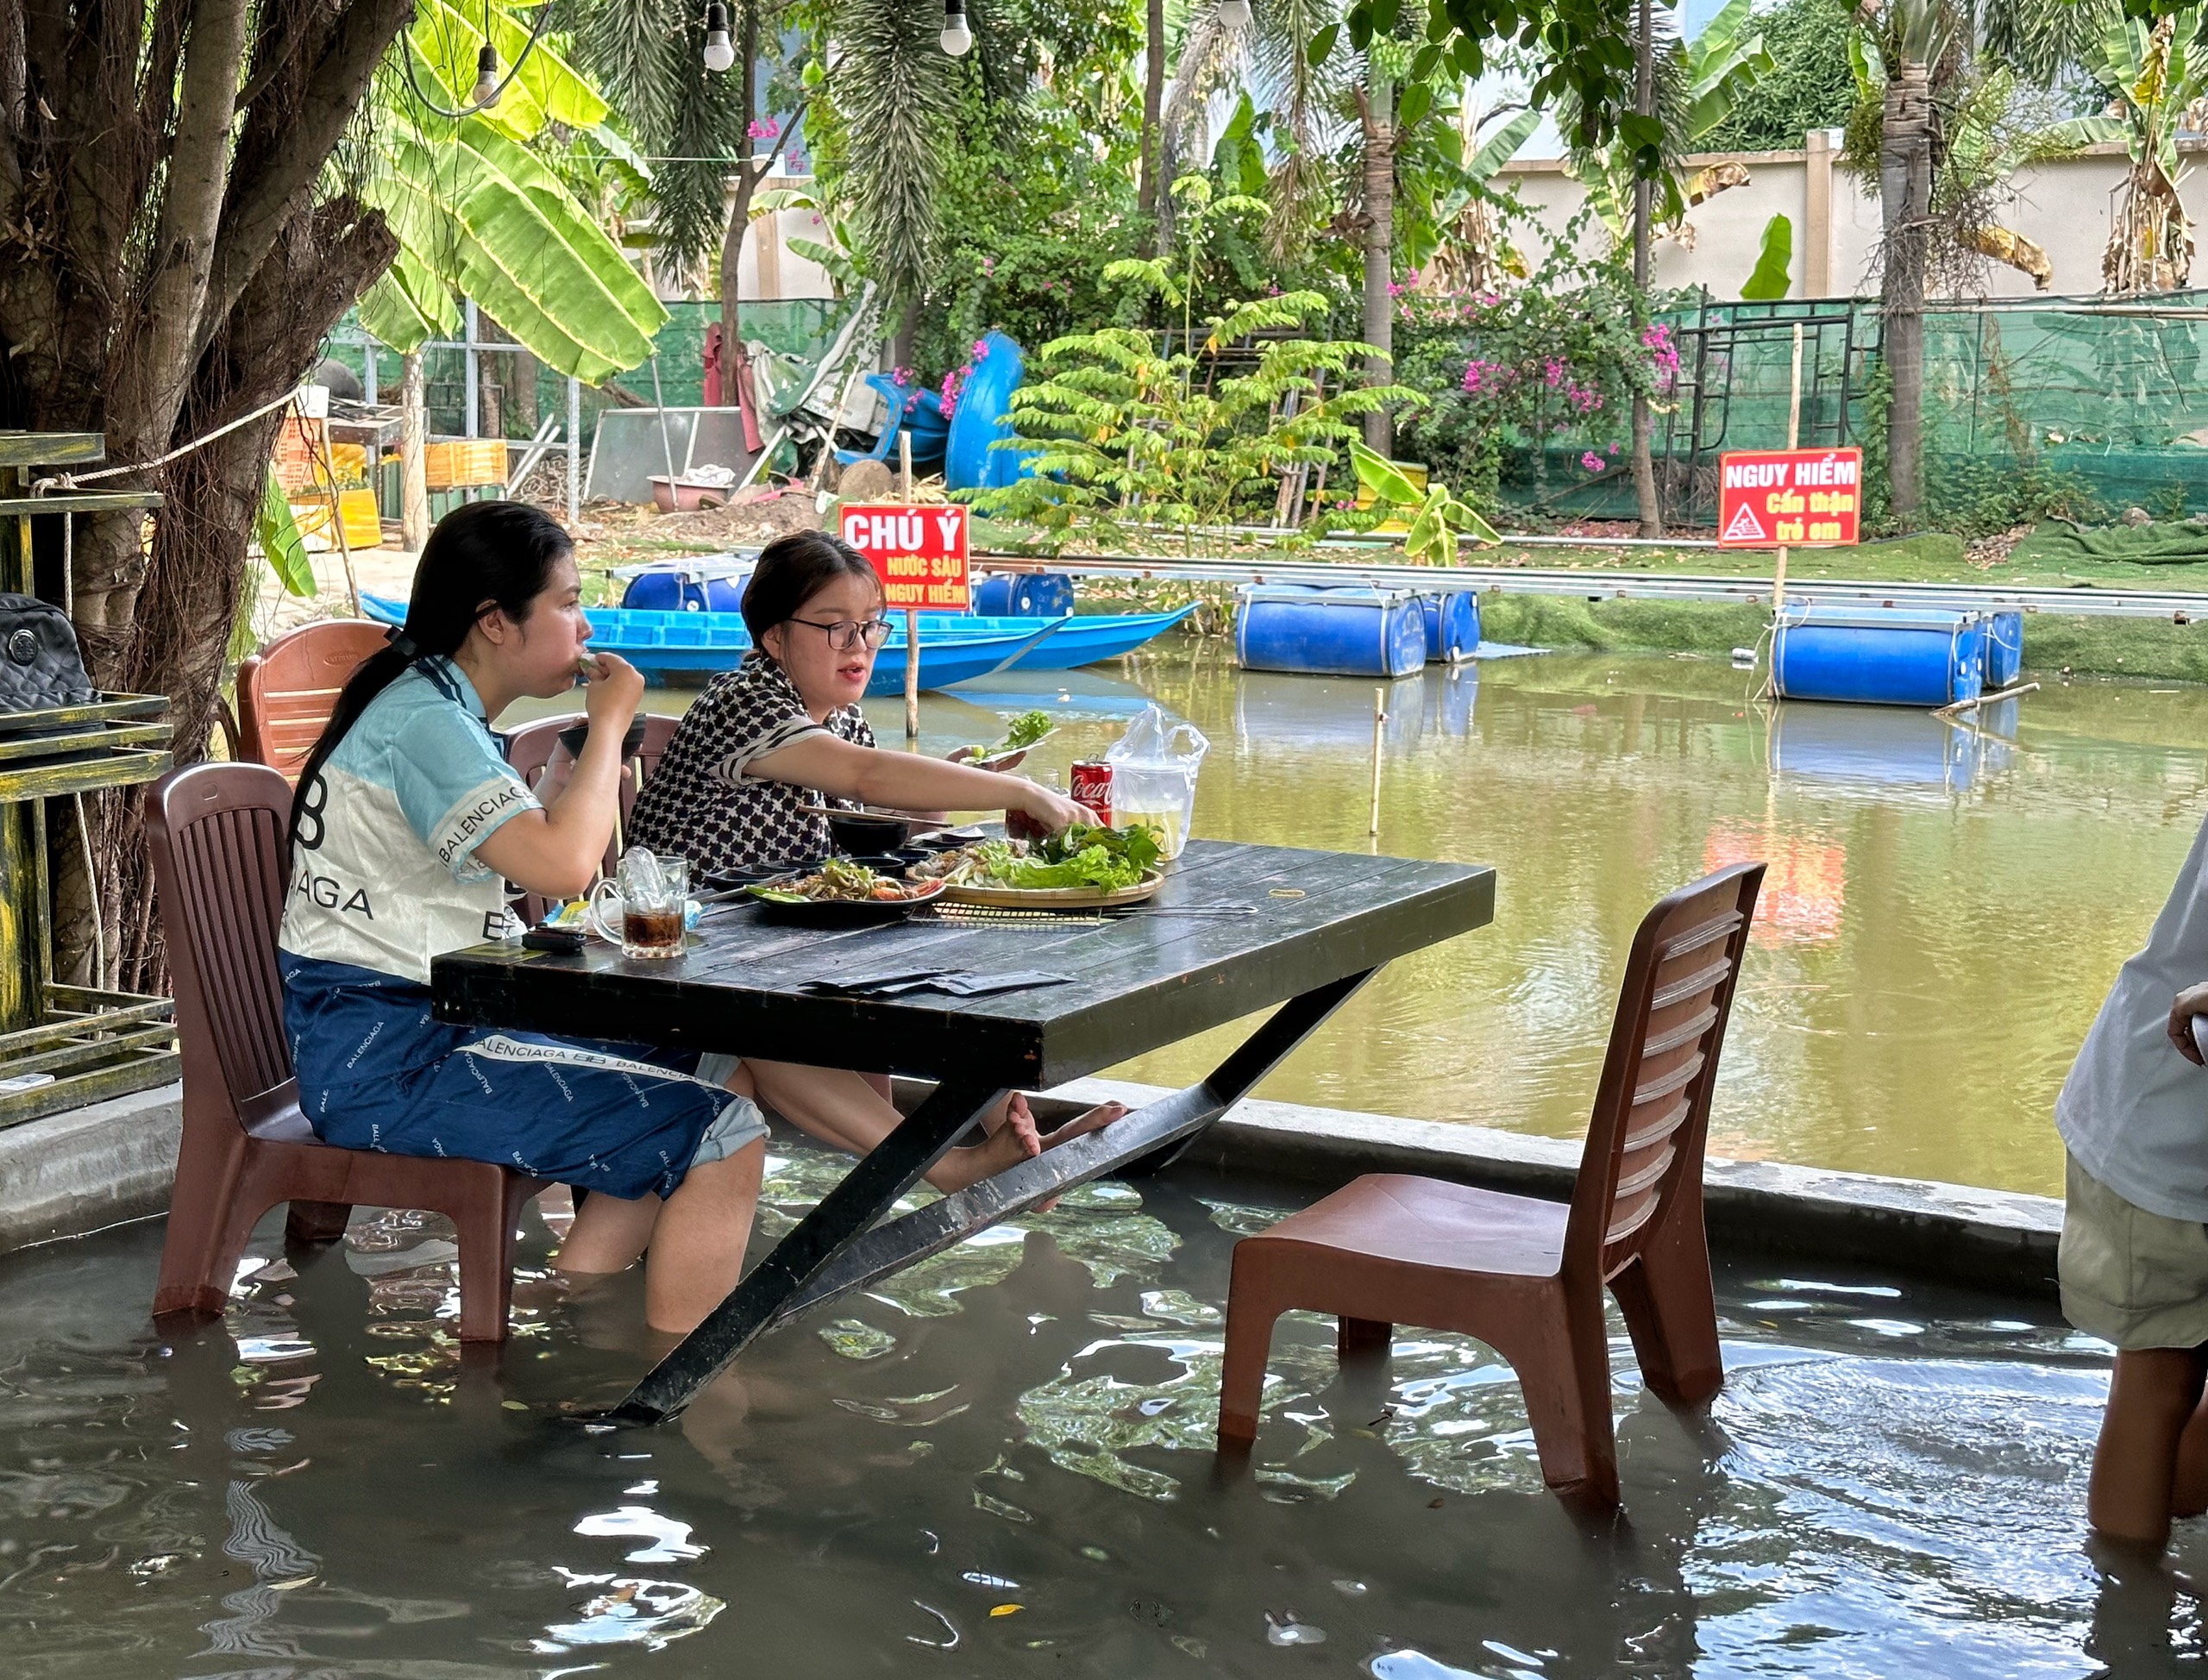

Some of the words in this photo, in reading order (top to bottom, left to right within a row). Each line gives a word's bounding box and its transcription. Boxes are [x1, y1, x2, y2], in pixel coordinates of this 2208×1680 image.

[1726, 463, 1789, 488] NGUY
[1795, 453, 1856, 486] HIỂM
[844, 509, 925, 551] CHÚ
[936, 510, 962, 551] Ý
[1809, 522, 1841, 540] em
[931, 555, 963, 578] SÂU
[885, 583, 925, 603] NGUY
